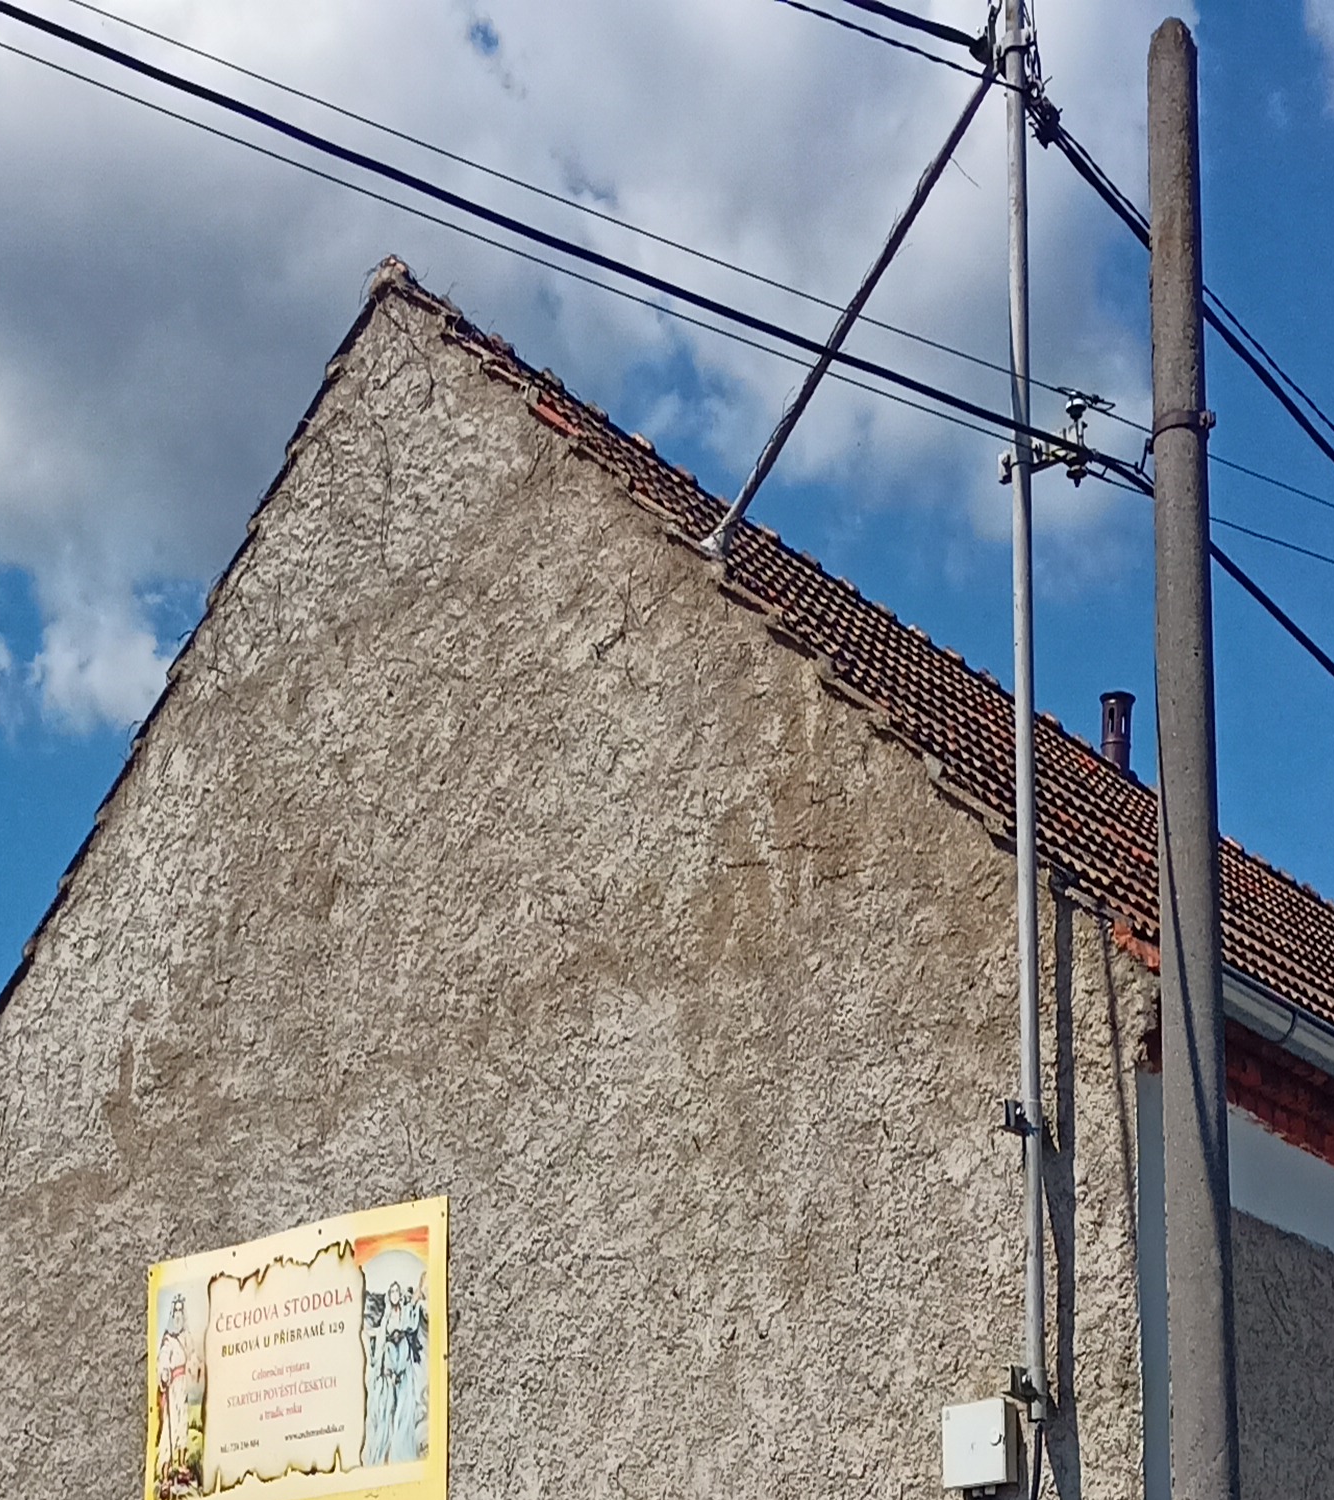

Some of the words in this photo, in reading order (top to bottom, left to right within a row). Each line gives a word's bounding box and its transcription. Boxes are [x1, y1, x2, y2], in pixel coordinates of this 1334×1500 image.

[216, 1303, 279, 1333] ČECHOVA
[284, 1286, 353, 1317] STODOLA
[221, 1335, 260, 1358] BUKOVÁ
[263, 1336, 271, 1348] U
[273, 1321, 326, 1345] PŘÍBRAMÉ
[329, 1321, 345, 1334] 129
